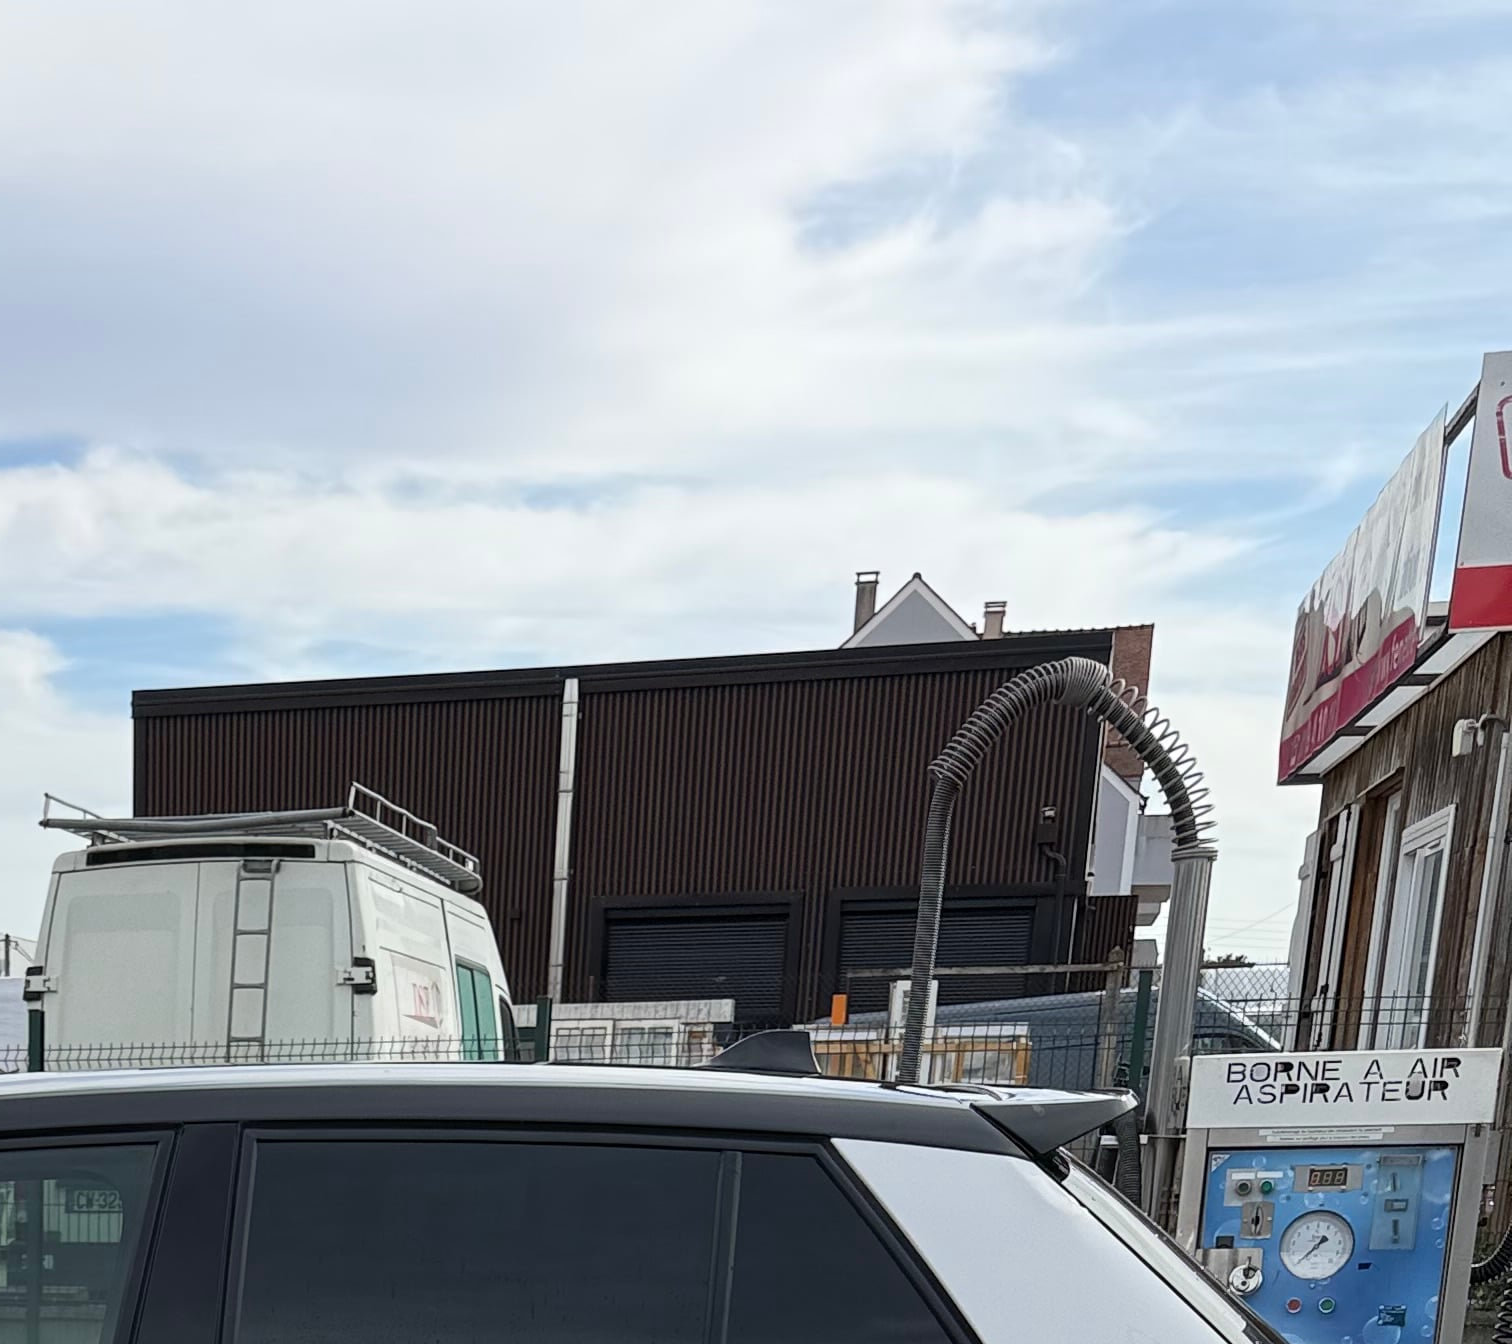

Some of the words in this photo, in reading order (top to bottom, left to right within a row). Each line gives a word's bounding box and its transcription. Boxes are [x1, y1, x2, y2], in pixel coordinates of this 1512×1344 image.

[1226, 1060, 1342, 1083] BORNE
[1363, 1059, 1384, 1081] A
[1408, 1057, 1462, 1080] AIR
[1233, 1080, 1449, 1105] ASPIRATEUR
